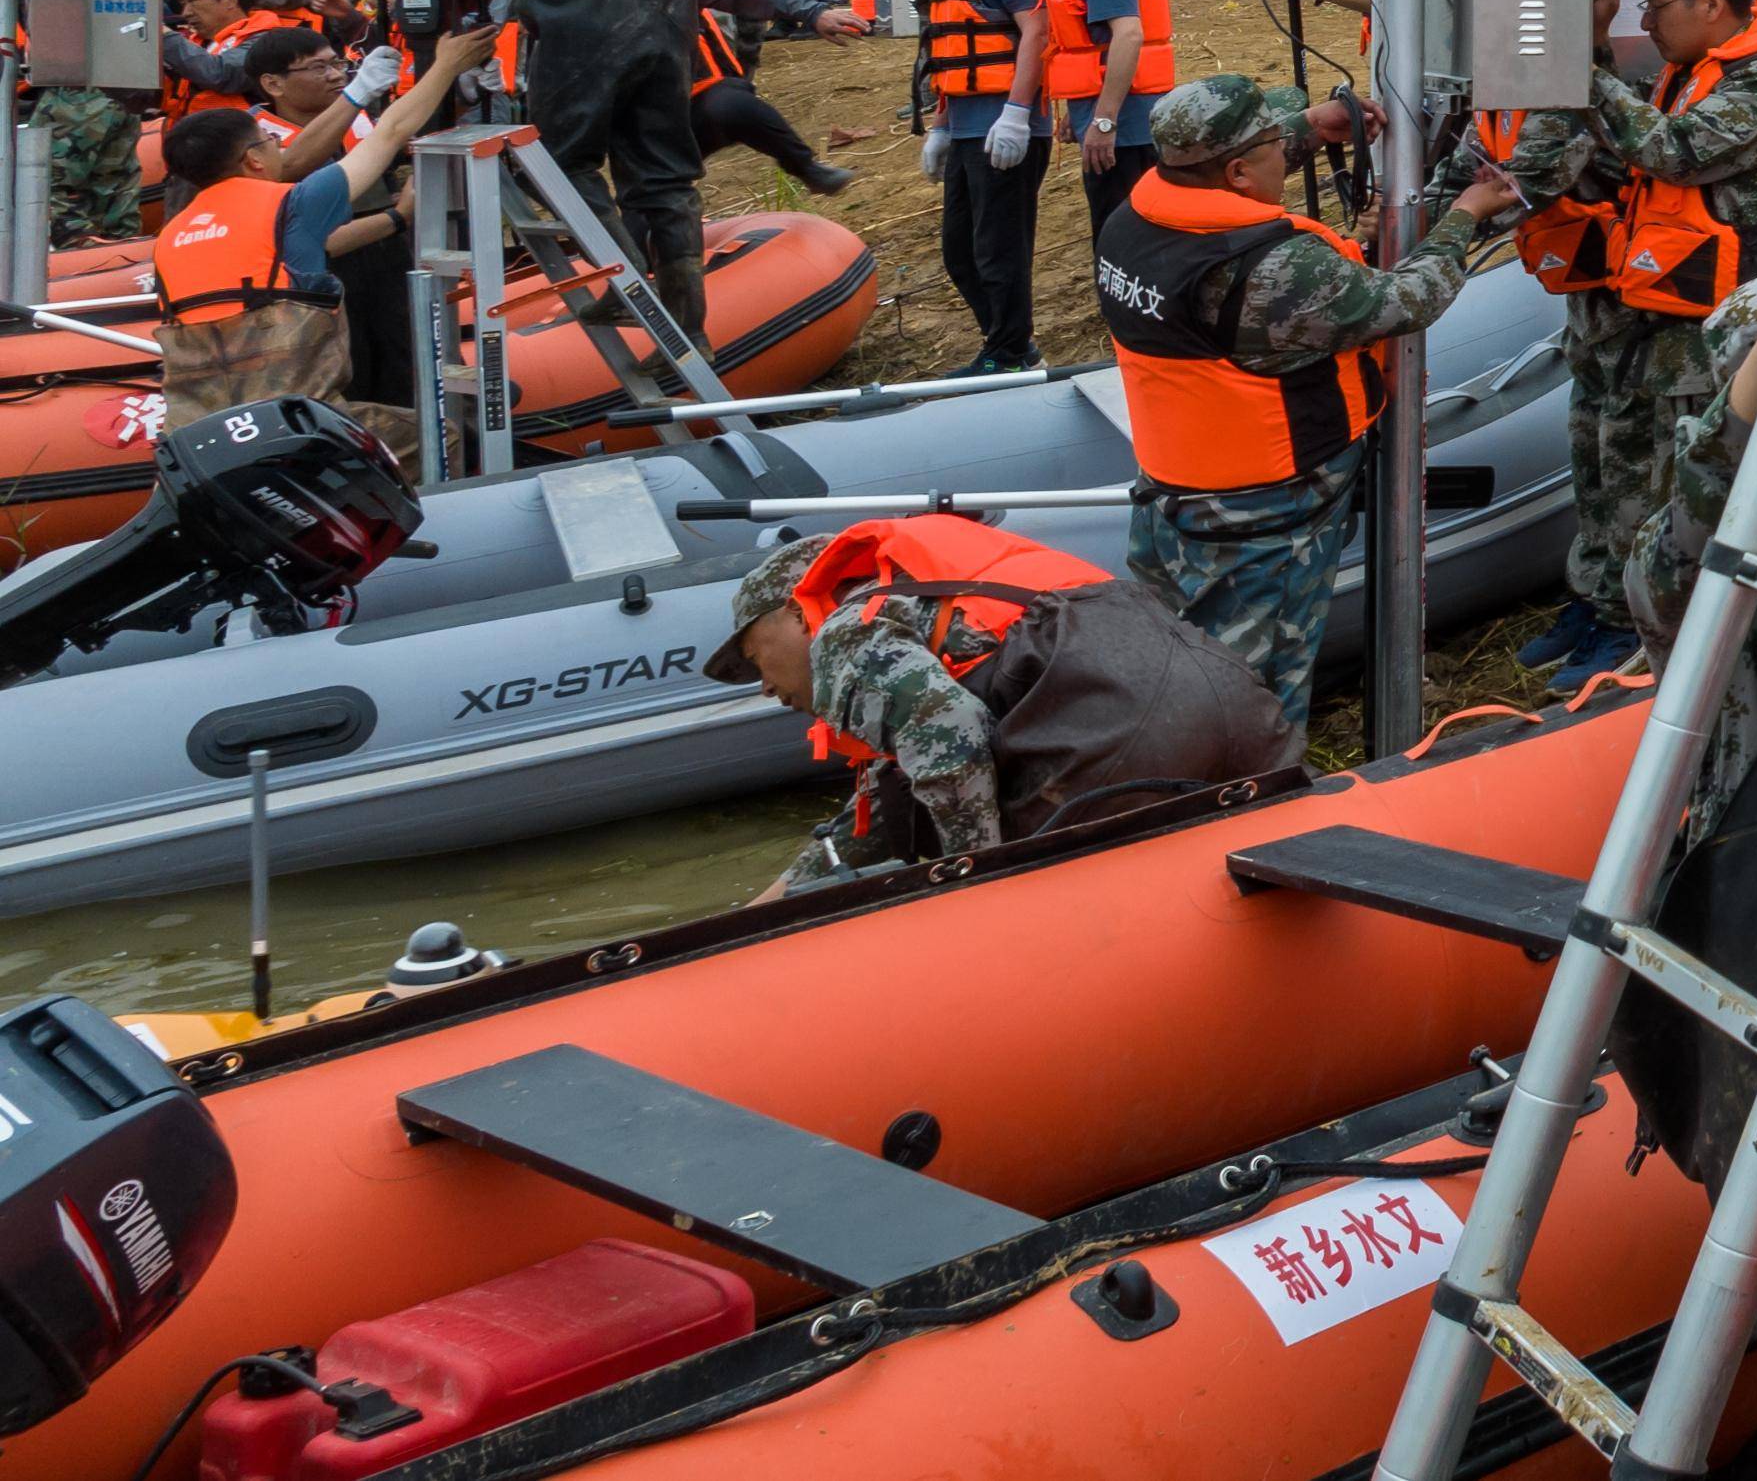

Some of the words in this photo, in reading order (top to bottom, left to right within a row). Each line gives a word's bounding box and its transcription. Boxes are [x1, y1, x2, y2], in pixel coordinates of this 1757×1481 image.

[1098, 255, 1166, 321] 河南水文
[225, 411, 260, 444] 20
[453, 645, 697, 720] XG-STAR
[114, 1199, 174, 1295] YAMAHA
[1253, 1193, 1444, 1304] 新乡水文
